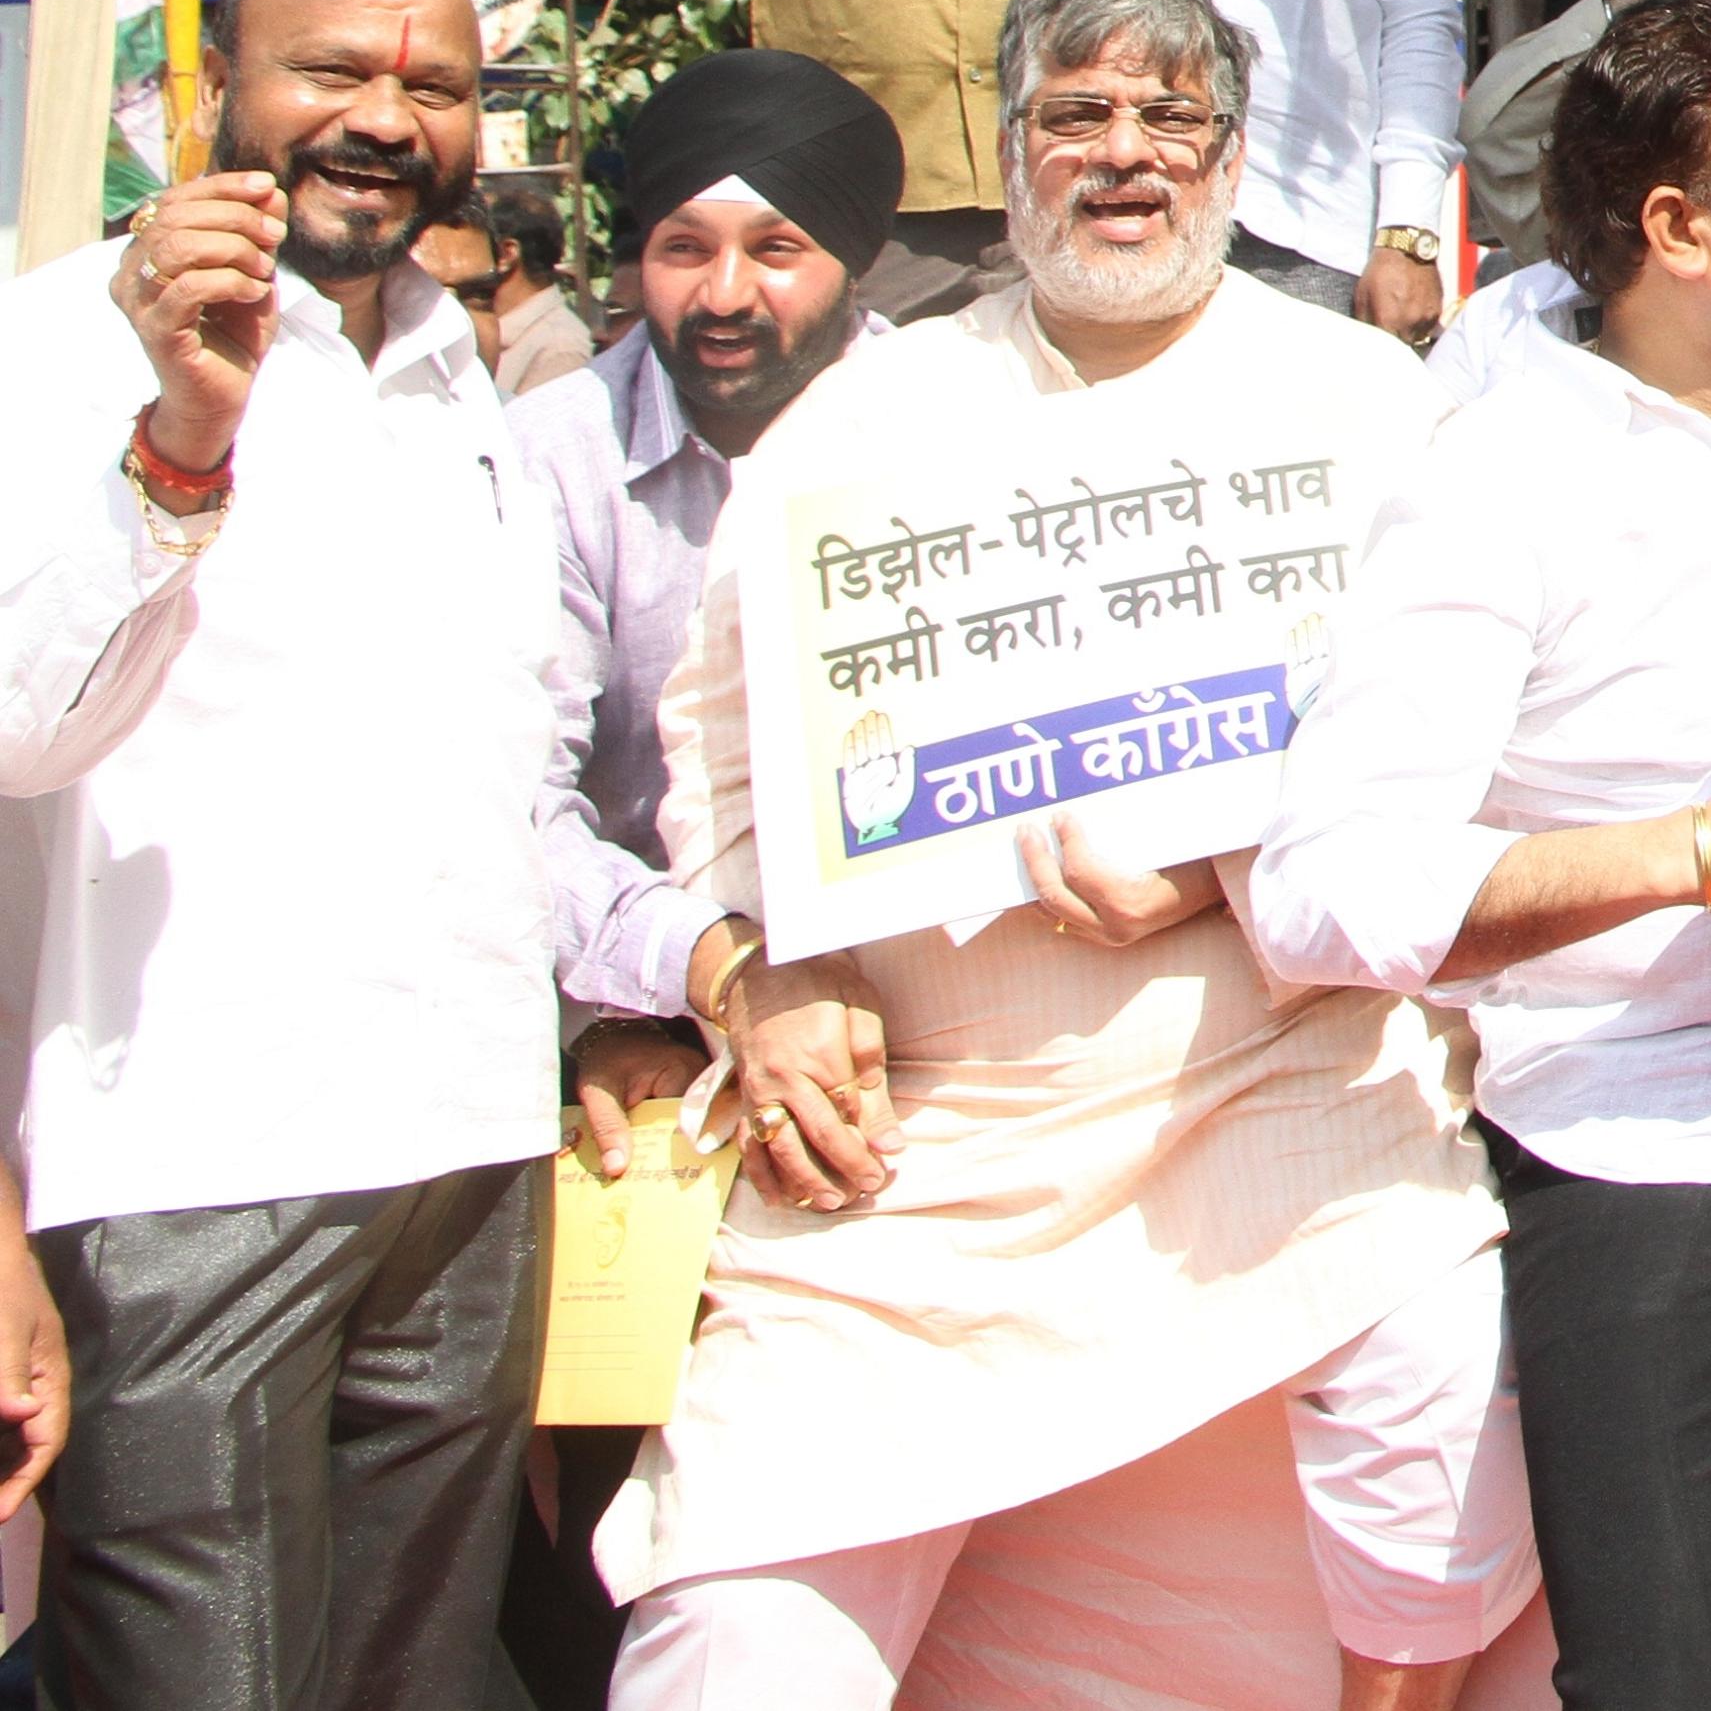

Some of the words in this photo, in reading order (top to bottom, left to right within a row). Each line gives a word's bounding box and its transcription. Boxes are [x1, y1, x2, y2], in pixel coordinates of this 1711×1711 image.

[1229, 459, 1335, 515] भाव
[821, 606, 943, 698] कमी
[1100, 545, 1223, 629] कमी
[1240, 543, 1351, 602] करा
[924, 722, 1064, 825] ठाणे
